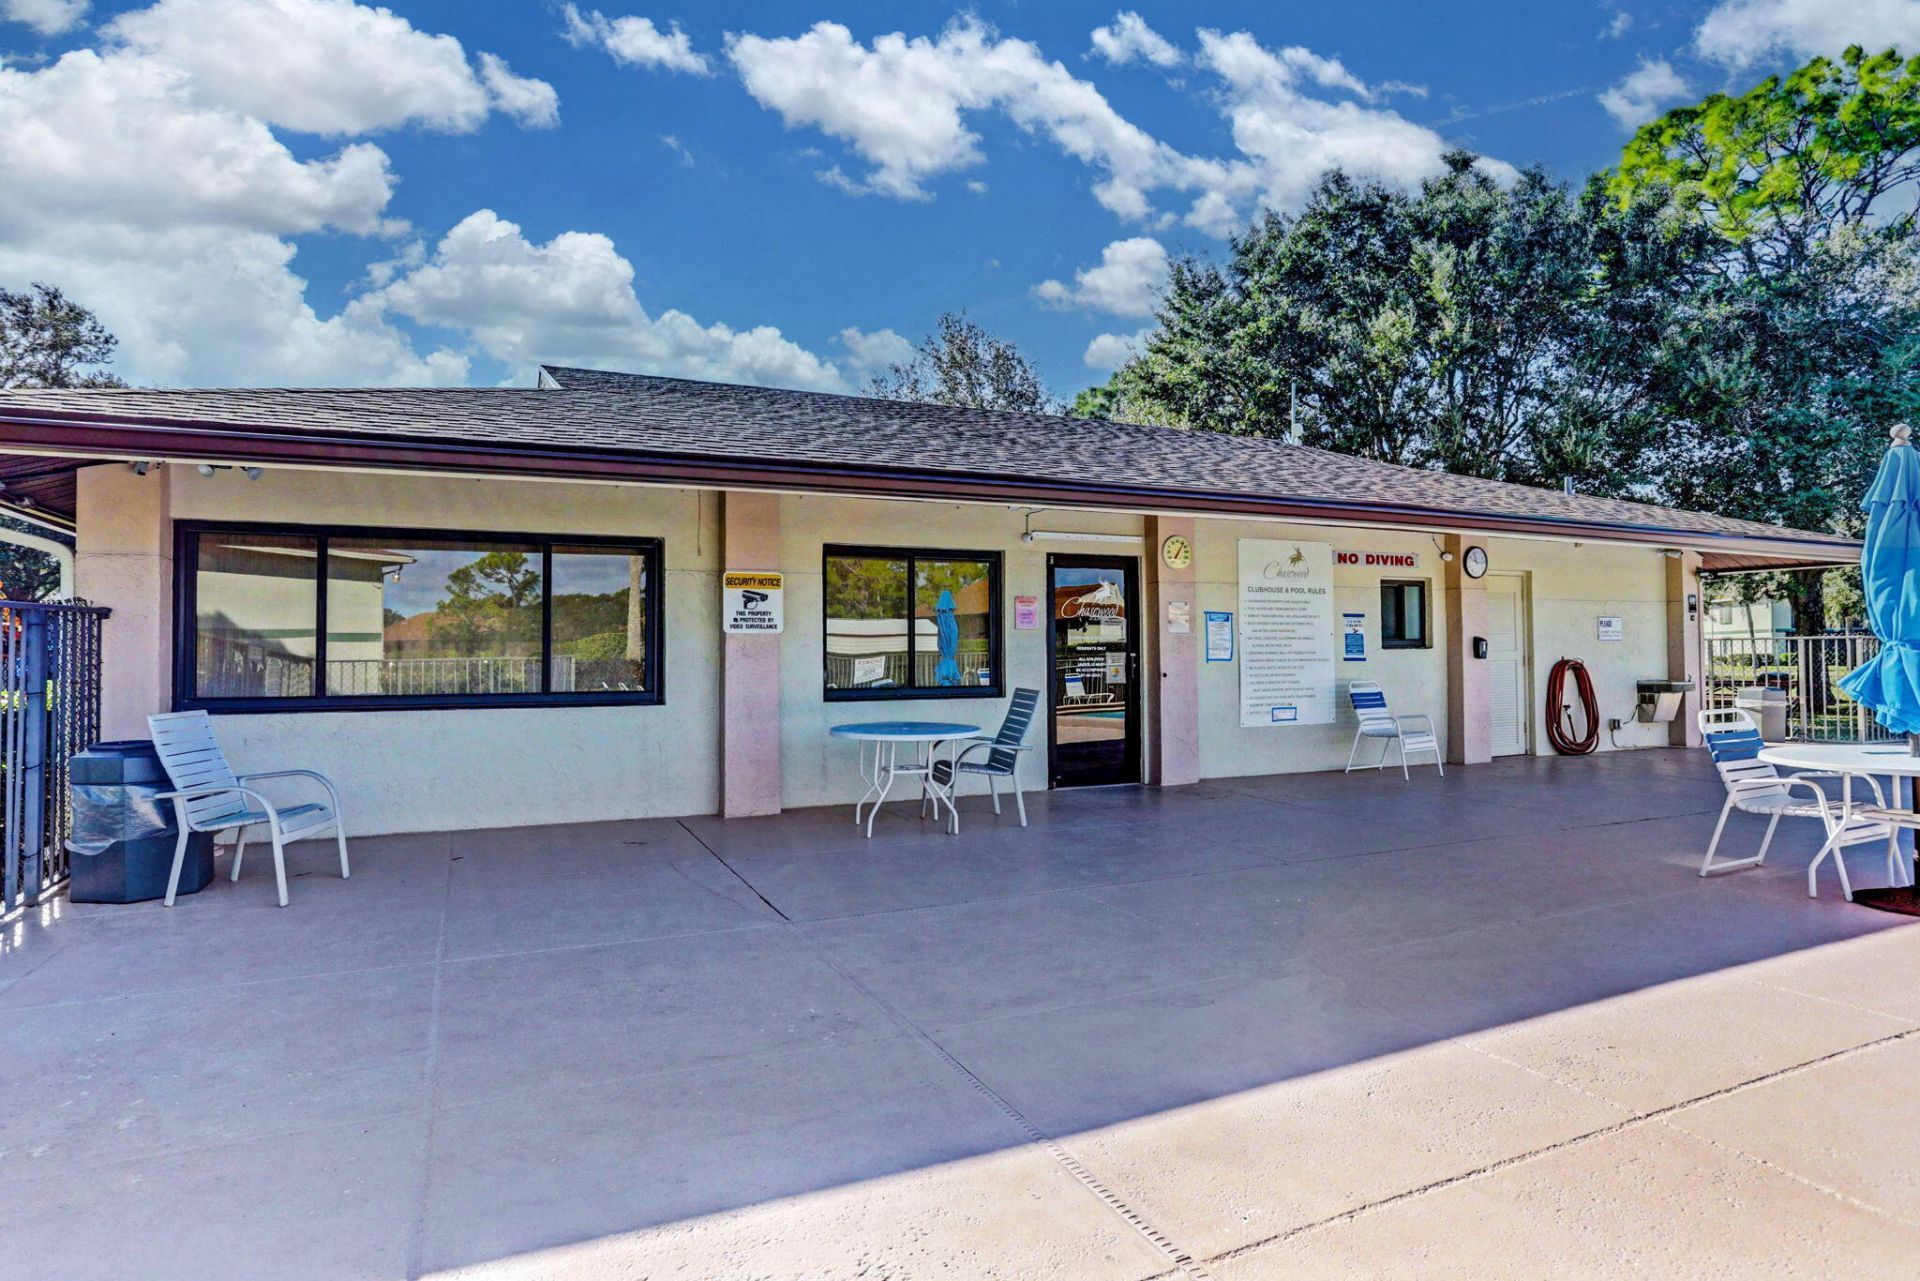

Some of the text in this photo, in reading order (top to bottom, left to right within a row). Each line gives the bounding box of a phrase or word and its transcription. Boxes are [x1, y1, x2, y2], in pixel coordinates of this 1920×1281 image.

[1337, 553, 1415, 567] NO DIVING
[725, 576, 781, 587] SECURITY NOTICE
[1247, 586, 1284, 594] CLUBHOUSE
